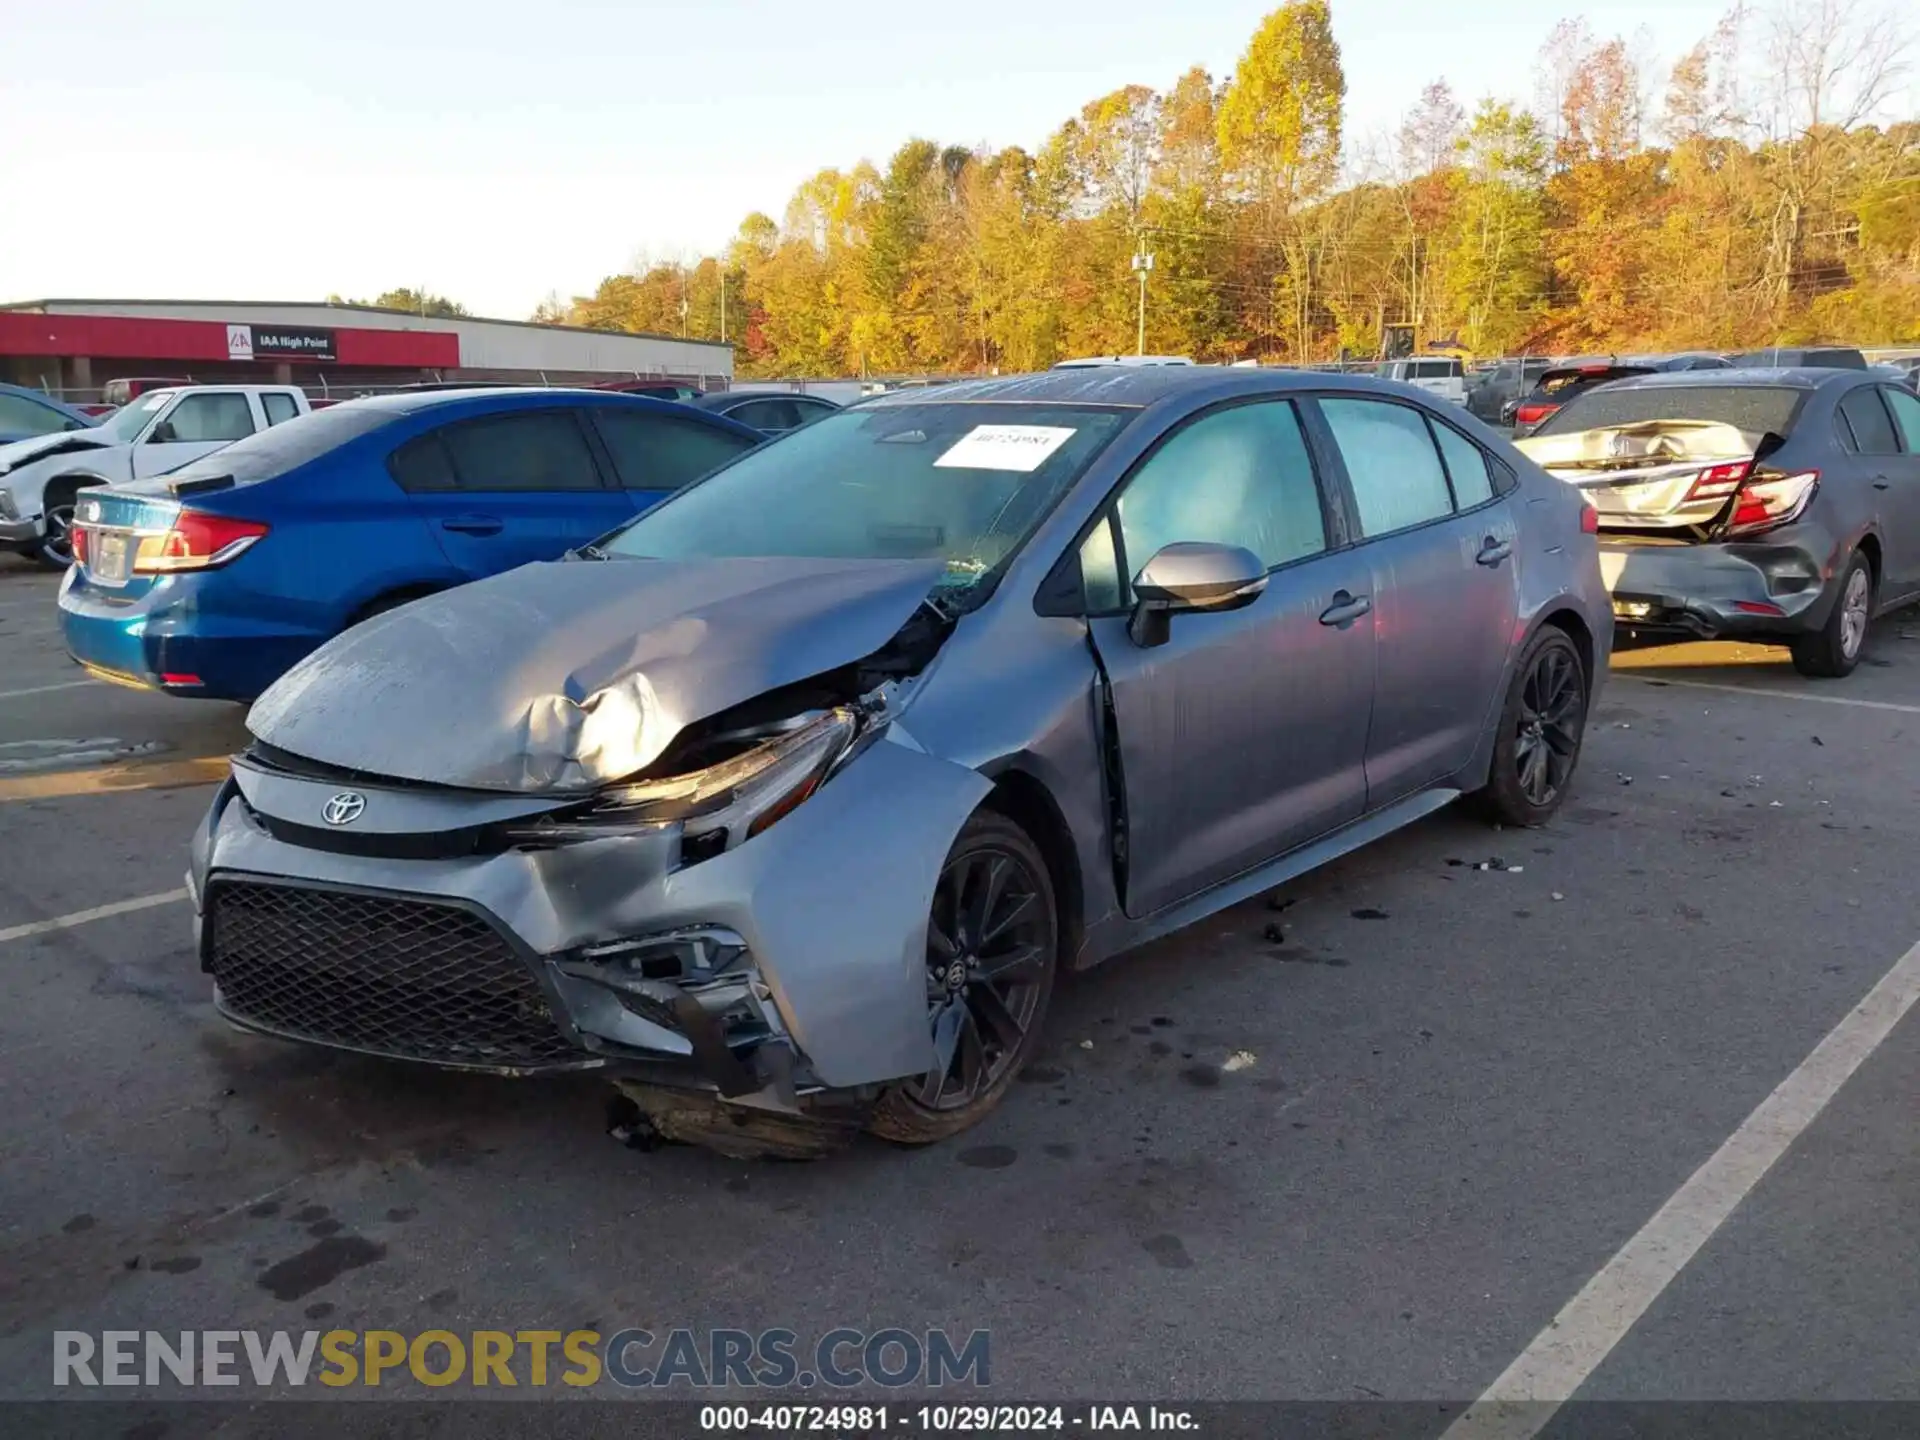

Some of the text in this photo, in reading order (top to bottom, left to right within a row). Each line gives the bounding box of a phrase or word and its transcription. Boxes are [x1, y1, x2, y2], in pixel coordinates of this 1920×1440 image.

[260, 335, 328, 349] IAA High Point
